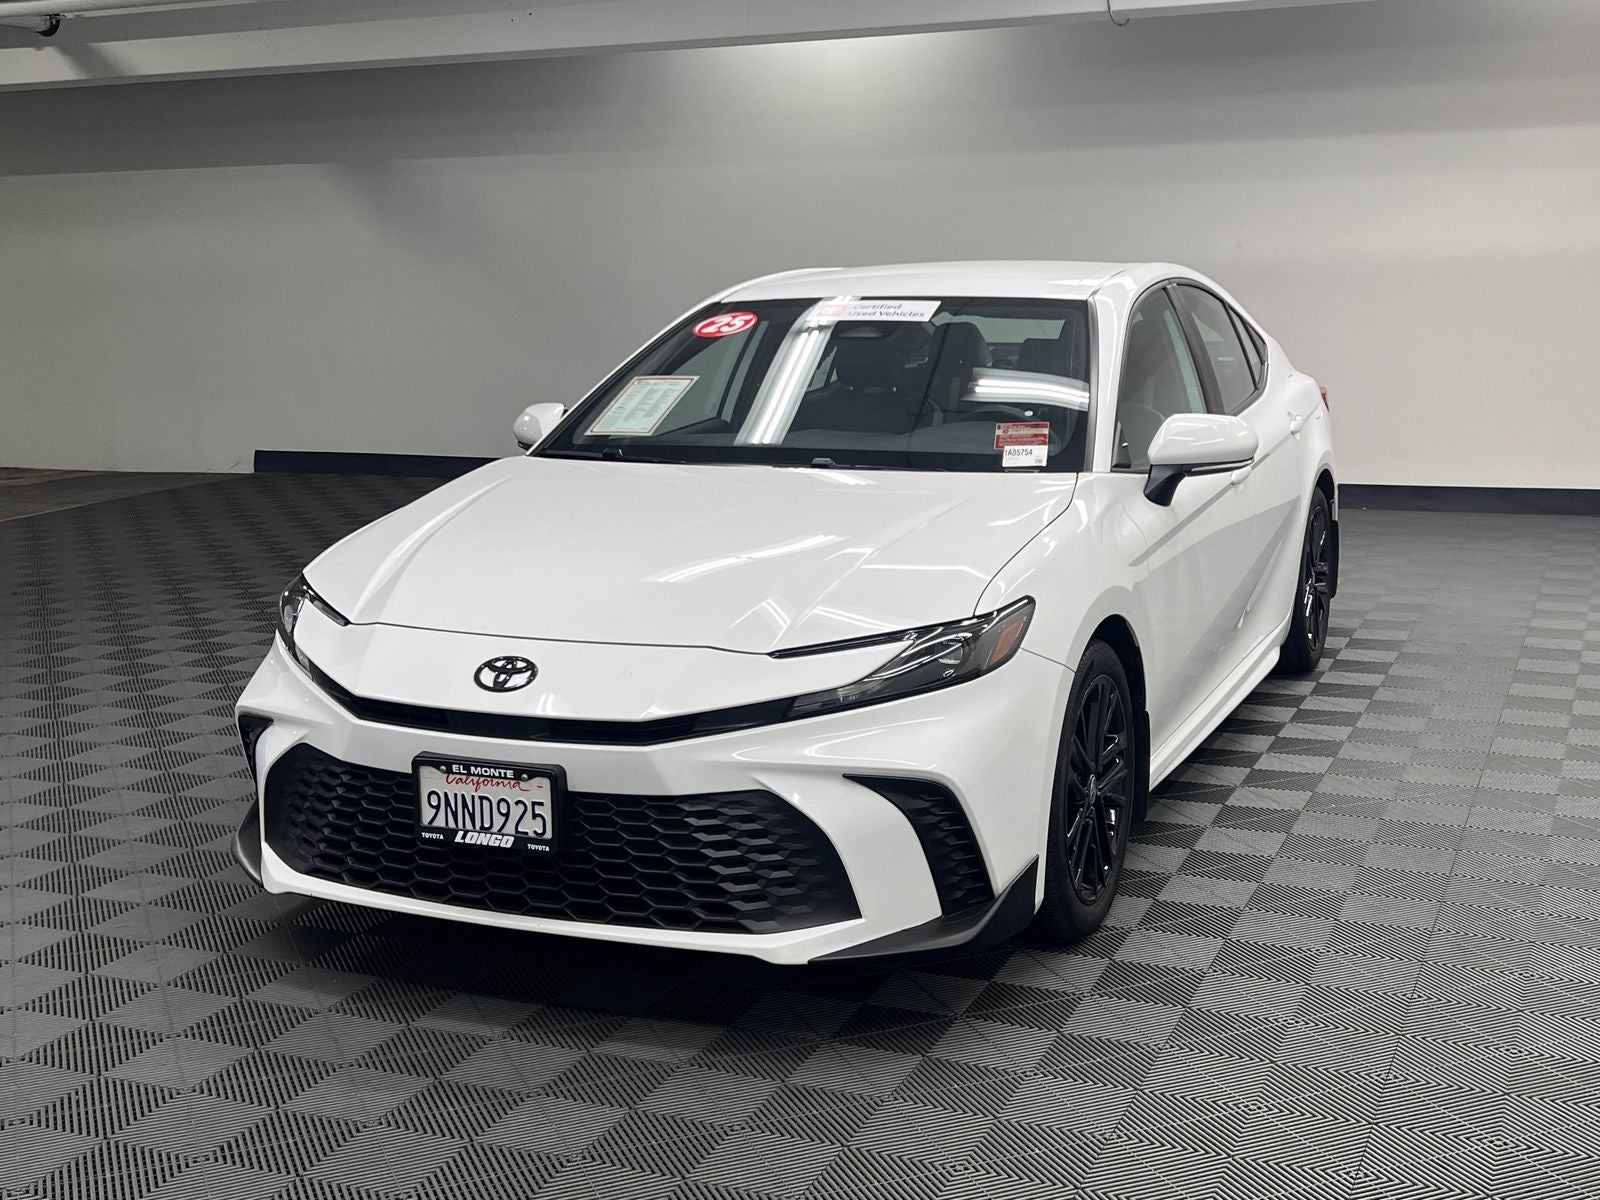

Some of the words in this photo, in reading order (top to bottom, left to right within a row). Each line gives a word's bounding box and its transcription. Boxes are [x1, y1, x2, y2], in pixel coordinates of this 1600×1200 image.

[701, 315, 754, 333] 25
[452, 764, 467, 774] EL
[470, 766, 515, 778] MONTE
[427, 790, 547, 838] 9NND925
[421, 832, 444, 840] TOYOTA
[454, 831, 515, 848] LONGO
[527, 843, 550, 852] TOYOTA
